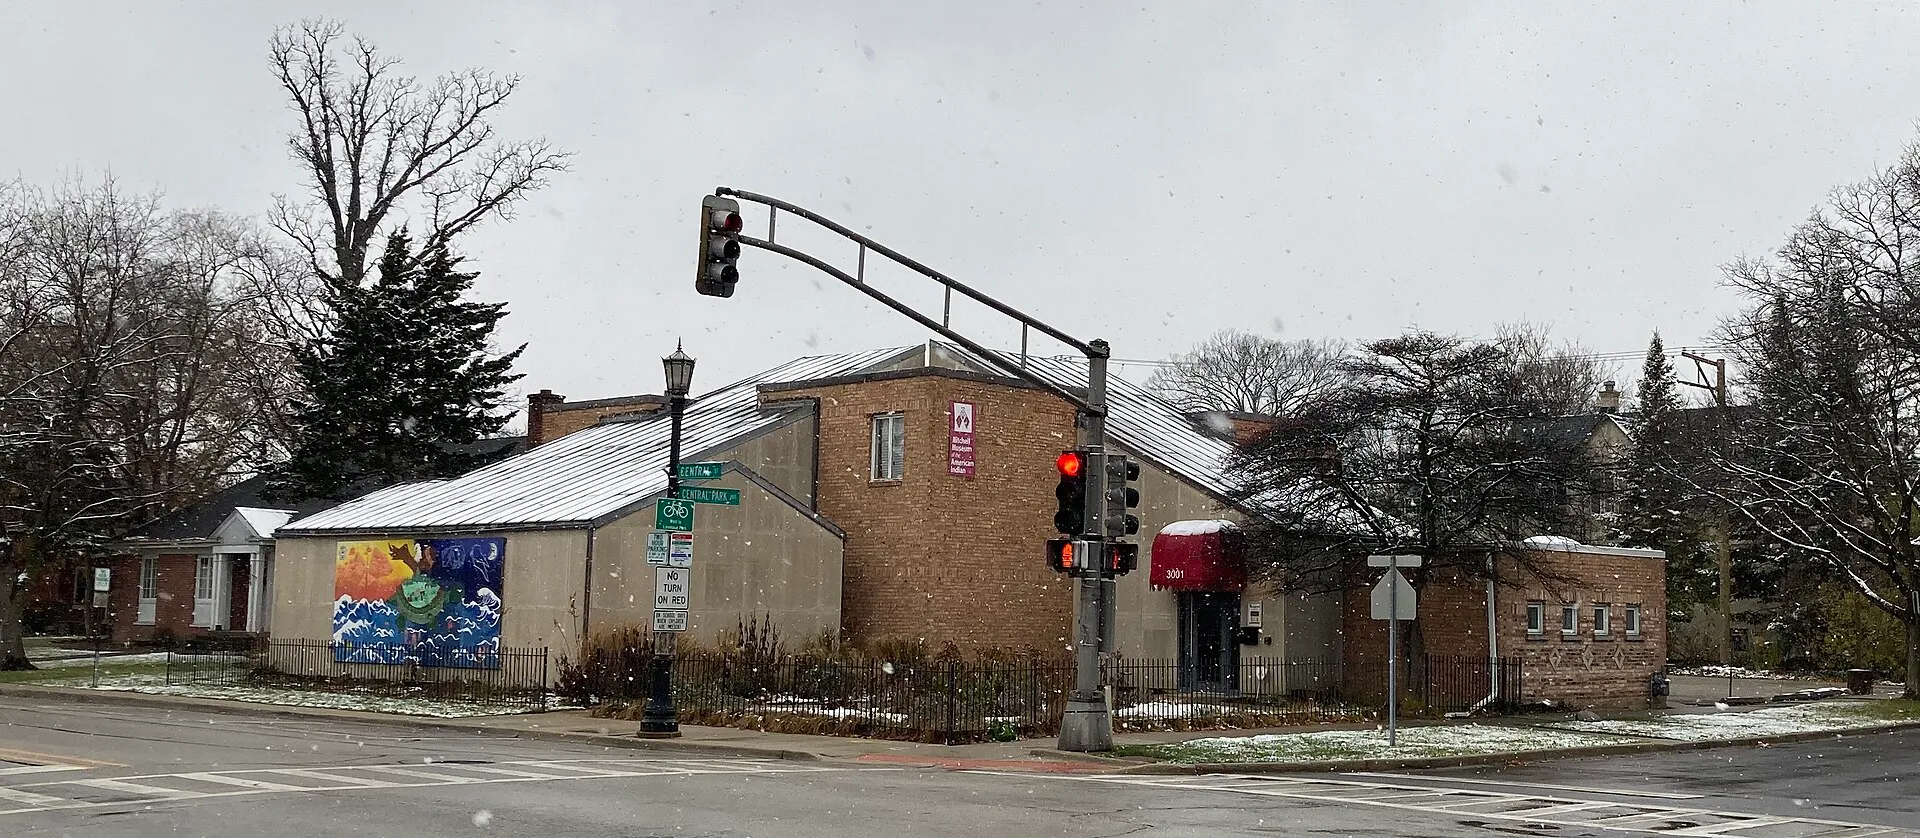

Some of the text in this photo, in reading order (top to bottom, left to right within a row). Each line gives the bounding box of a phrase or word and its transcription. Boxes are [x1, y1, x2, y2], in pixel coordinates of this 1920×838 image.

[952, 436, 971, 445] Mitchell
[951, 444, 973, 452] Museum
[950, 458, 975, 467] American
[950, 466, 967, 474] Indian
[681, 489, 708, 500] CENTRAL
[711, 490, 728, 501] PARK
[667, 571, 679, 581] NO
[1165, 569, 1184, 579] 3001
[663, 583, 682, 593] TURN
[657, 595, 686, 605] ON RED
